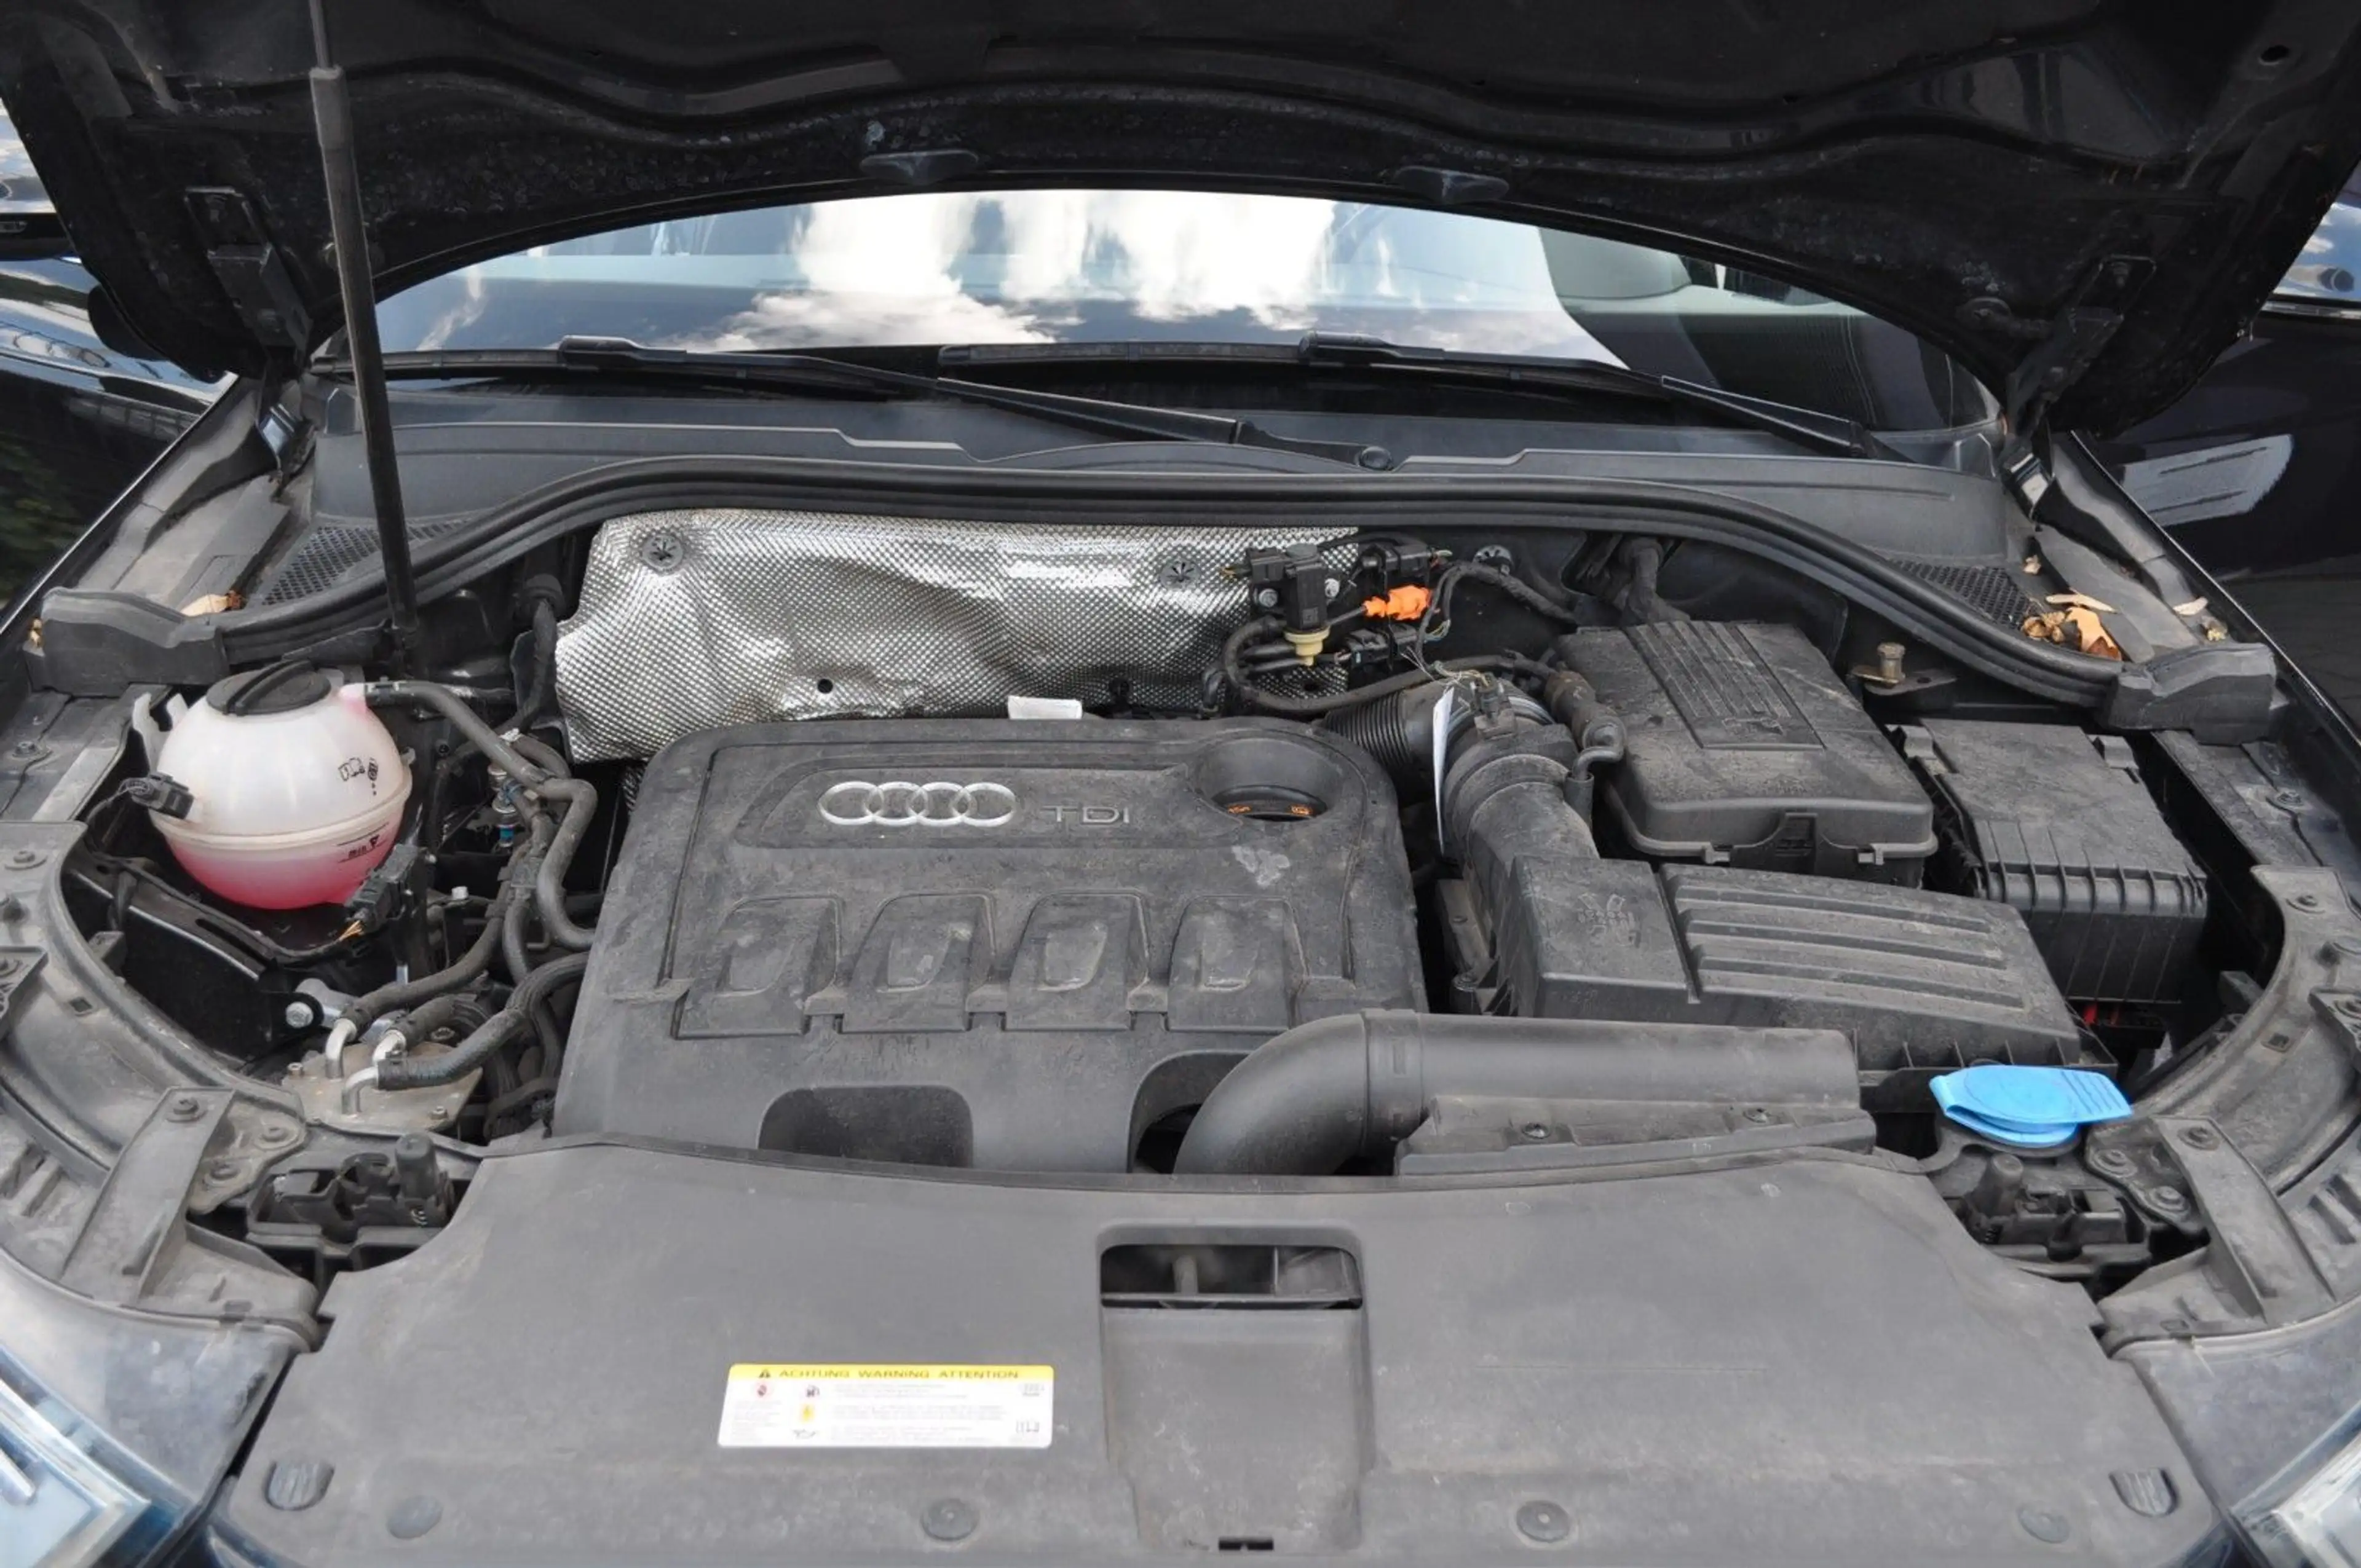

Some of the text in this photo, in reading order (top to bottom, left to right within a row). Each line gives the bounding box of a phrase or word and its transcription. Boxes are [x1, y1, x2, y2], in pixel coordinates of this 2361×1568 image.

[1040, 805, 1129, 825] TDI
[348, 845, 367, 859] min
[779, 1369, 1019, 1379] ACHTUNG WARNING ATTENTION
